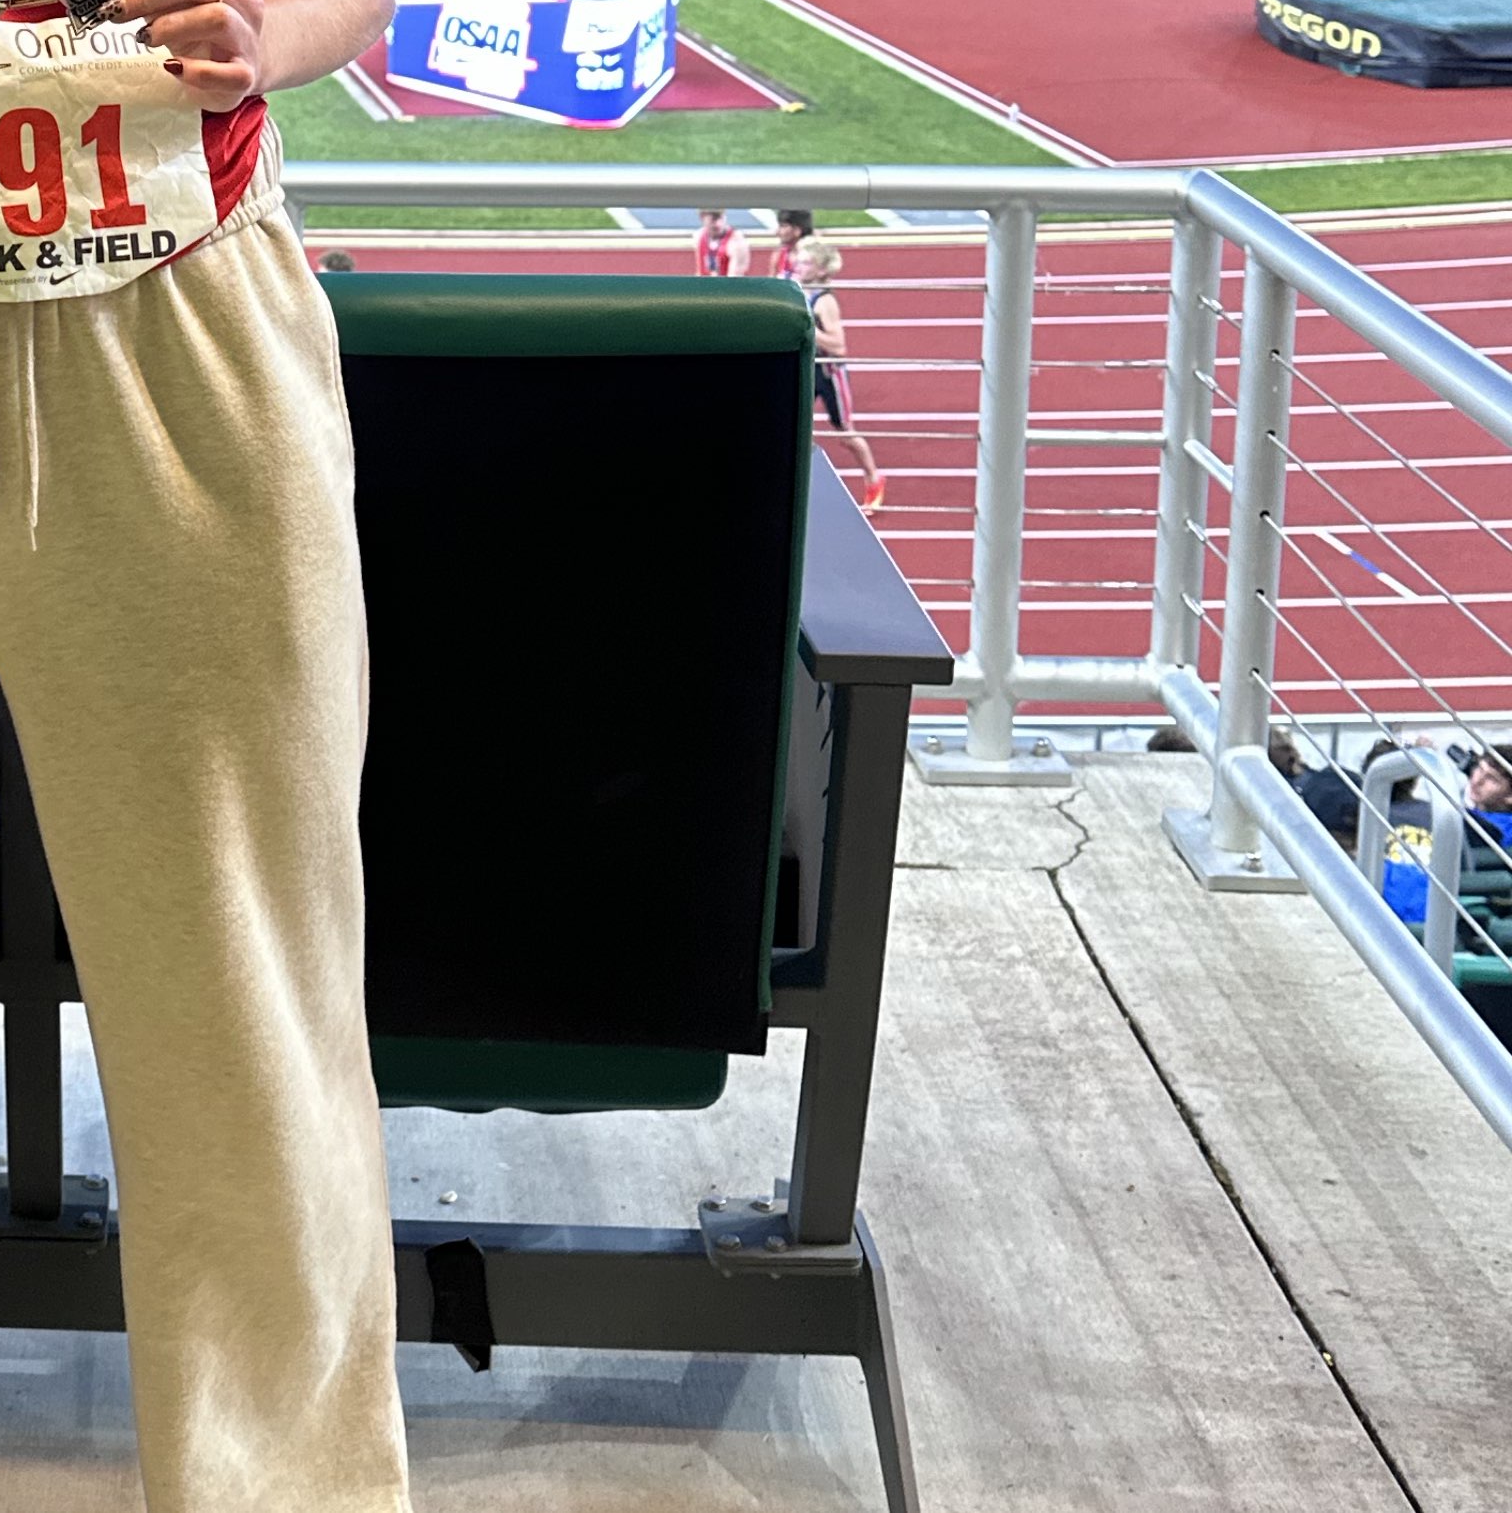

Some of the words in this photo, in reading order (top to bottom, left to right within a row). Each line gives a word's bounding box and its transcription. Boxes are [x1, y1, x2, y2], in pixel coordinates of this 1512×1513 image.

[443, 16, 520, 57] OSAA
[87, 60, 123, 70] CREDIT
[36, 240, 64, 269] &
[74, 230, 177, 267] FIELD
